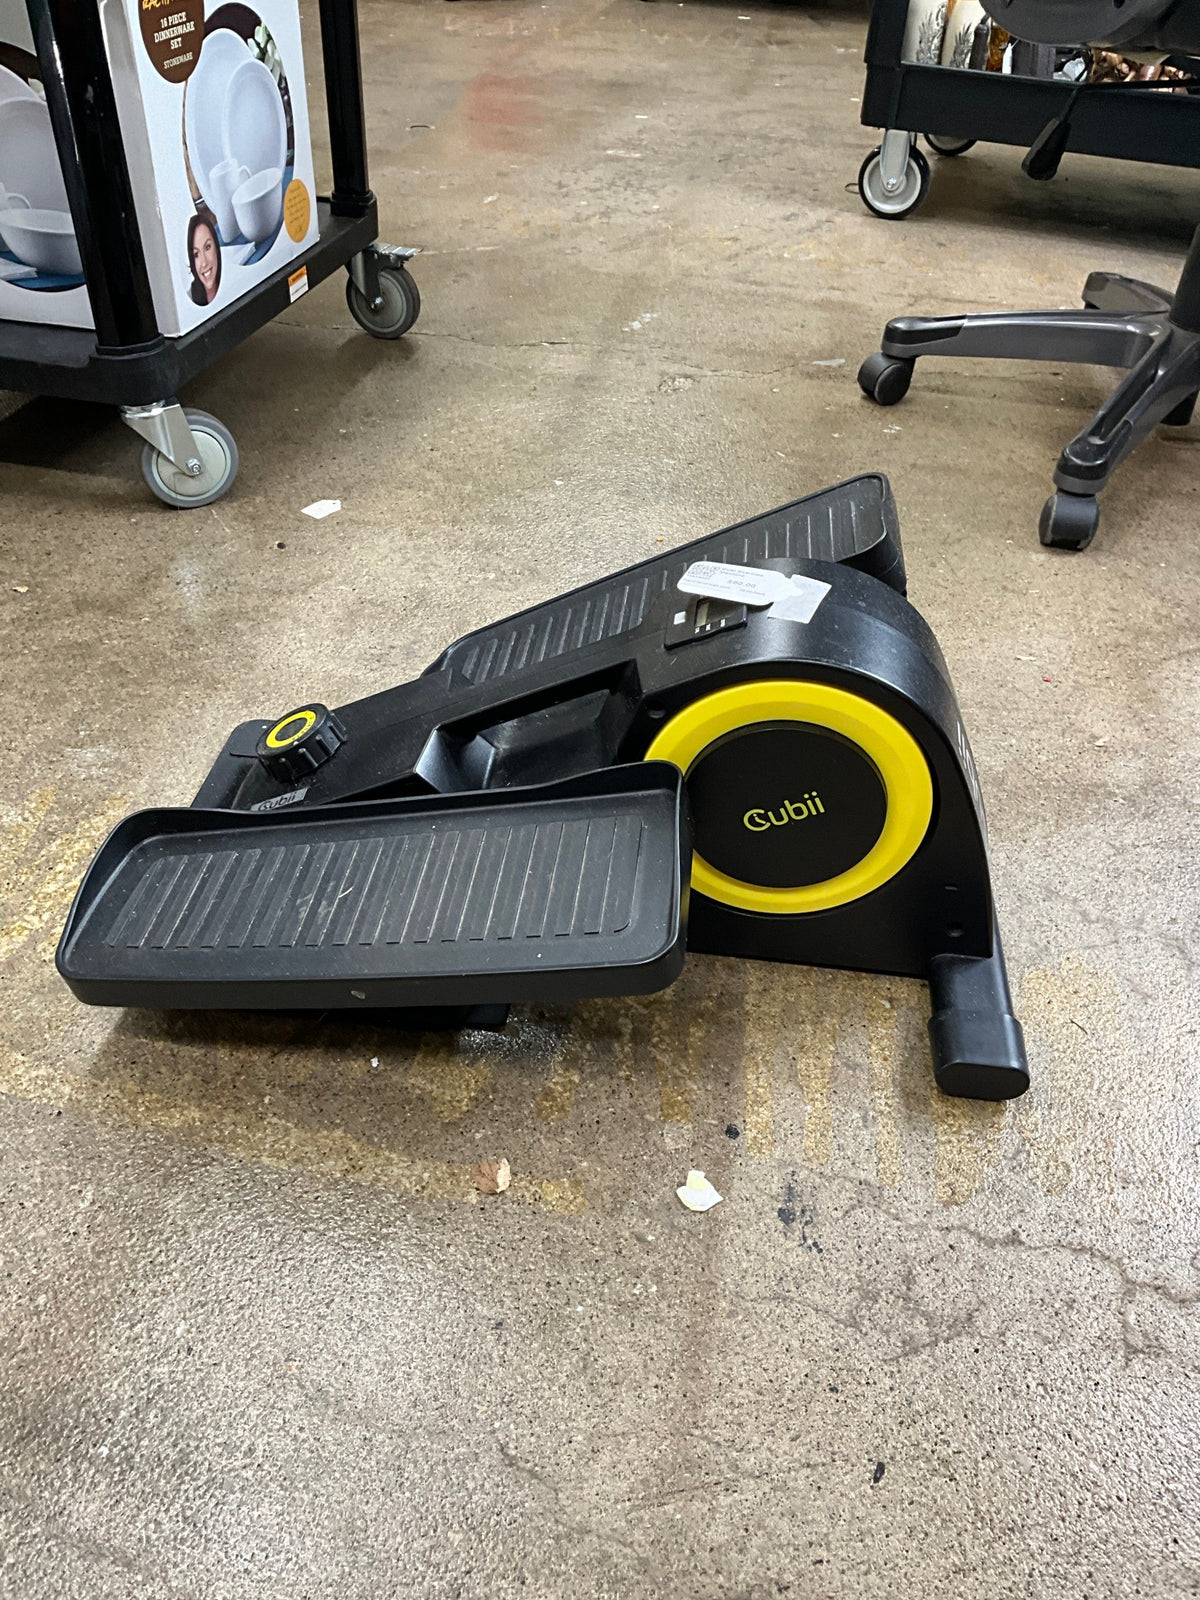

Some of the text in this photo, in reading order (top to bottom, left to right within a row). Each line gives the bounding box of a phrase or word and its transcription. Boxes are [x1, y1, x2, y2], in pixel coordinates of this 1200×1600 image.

[161, 12, 186, 29] 16 PIECE
[154, 21, 195, 43] DINNERWARE
[170, 37, 182, 50] SET
[164, 52, 193, 69] STONEWARE
[258, 791, 297, 811] Cubii
[743, 791, 825, 832] Cubii
